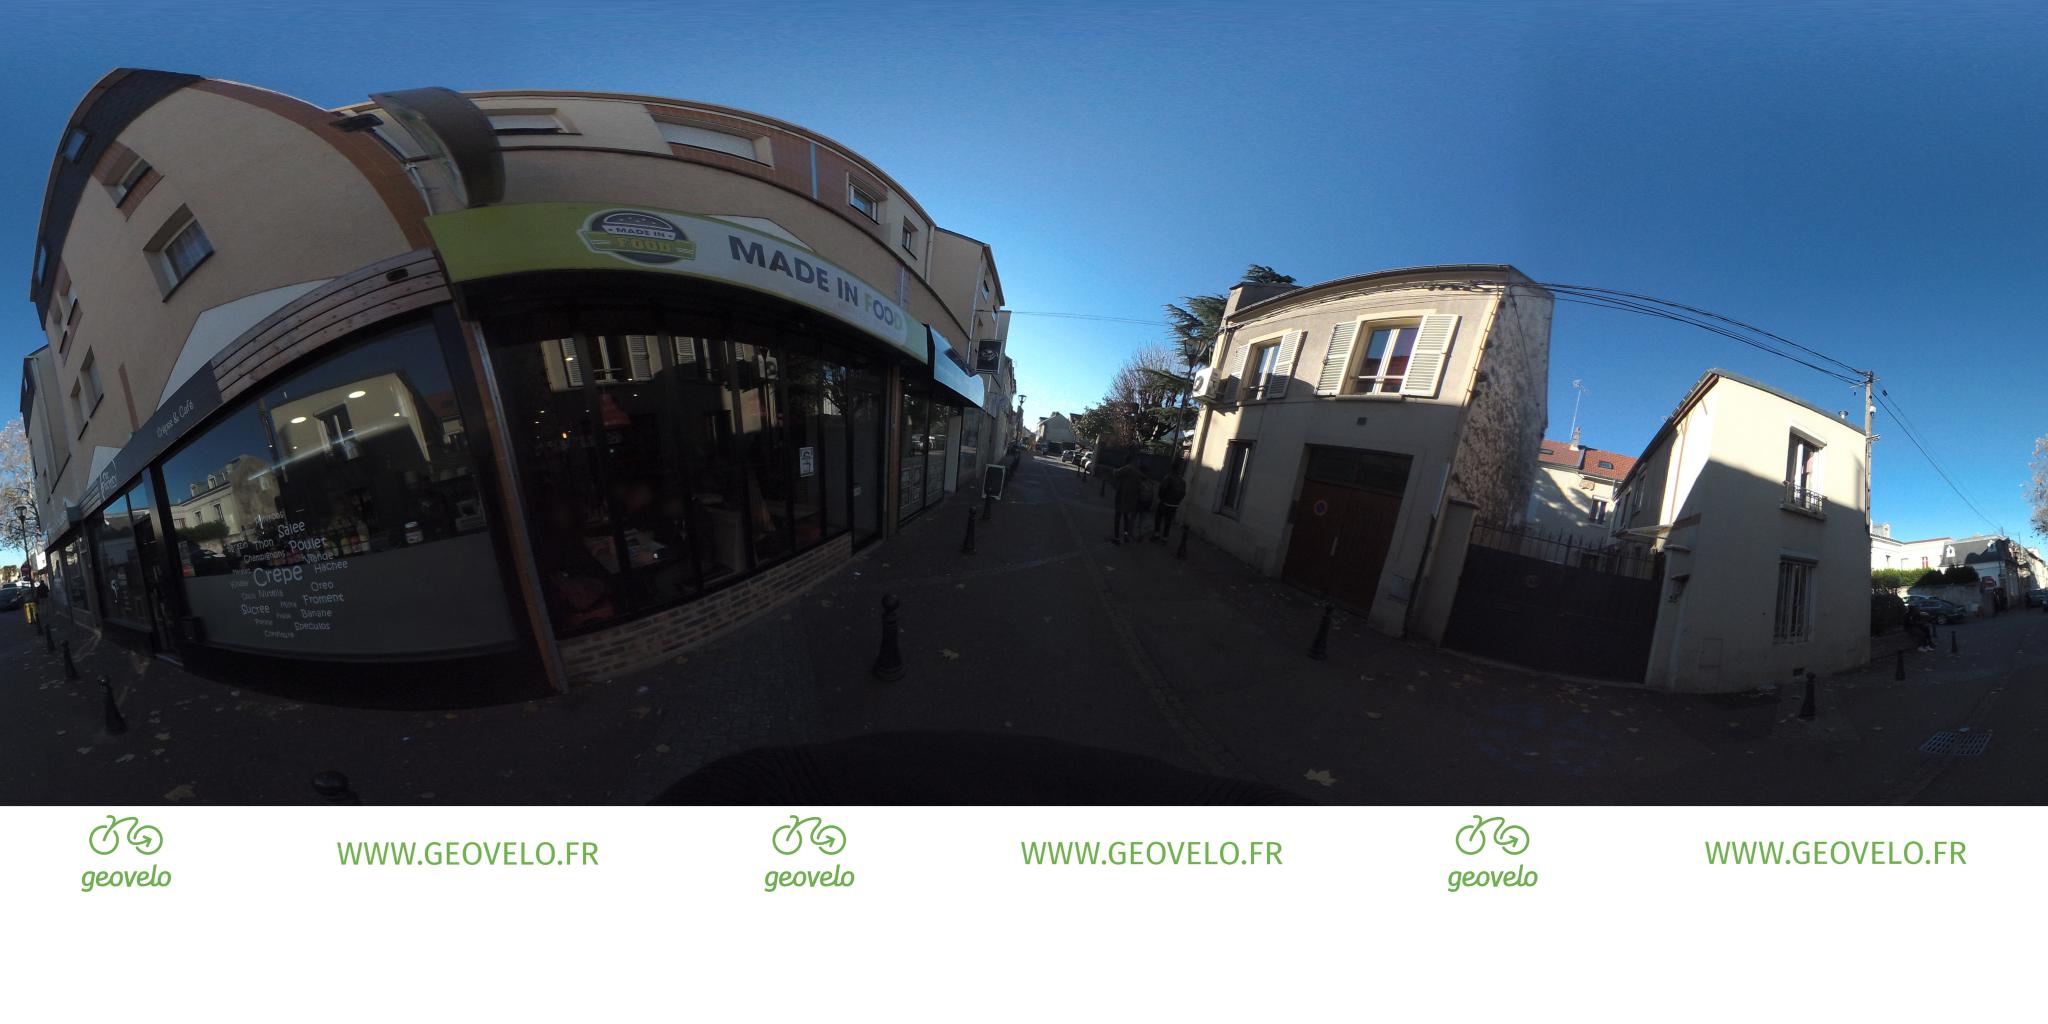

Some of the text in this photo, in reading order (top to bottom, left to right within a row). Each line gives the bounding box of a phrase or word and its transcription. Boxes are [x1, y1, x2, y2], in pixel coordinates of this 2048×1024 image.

[615, 226, 666, 239] MADE IN
[615, 236, 673, 252] FOOD
[728, 234, 903, 331] MADE IN FOOD
[255, 538, 274, 551] Thon
[287, 537, 329, 553] Poulet
[310, 581, 334, 592] Oreo
[302, 592, 345, 605] Froment
[301, 608, 333, 619] Banane
